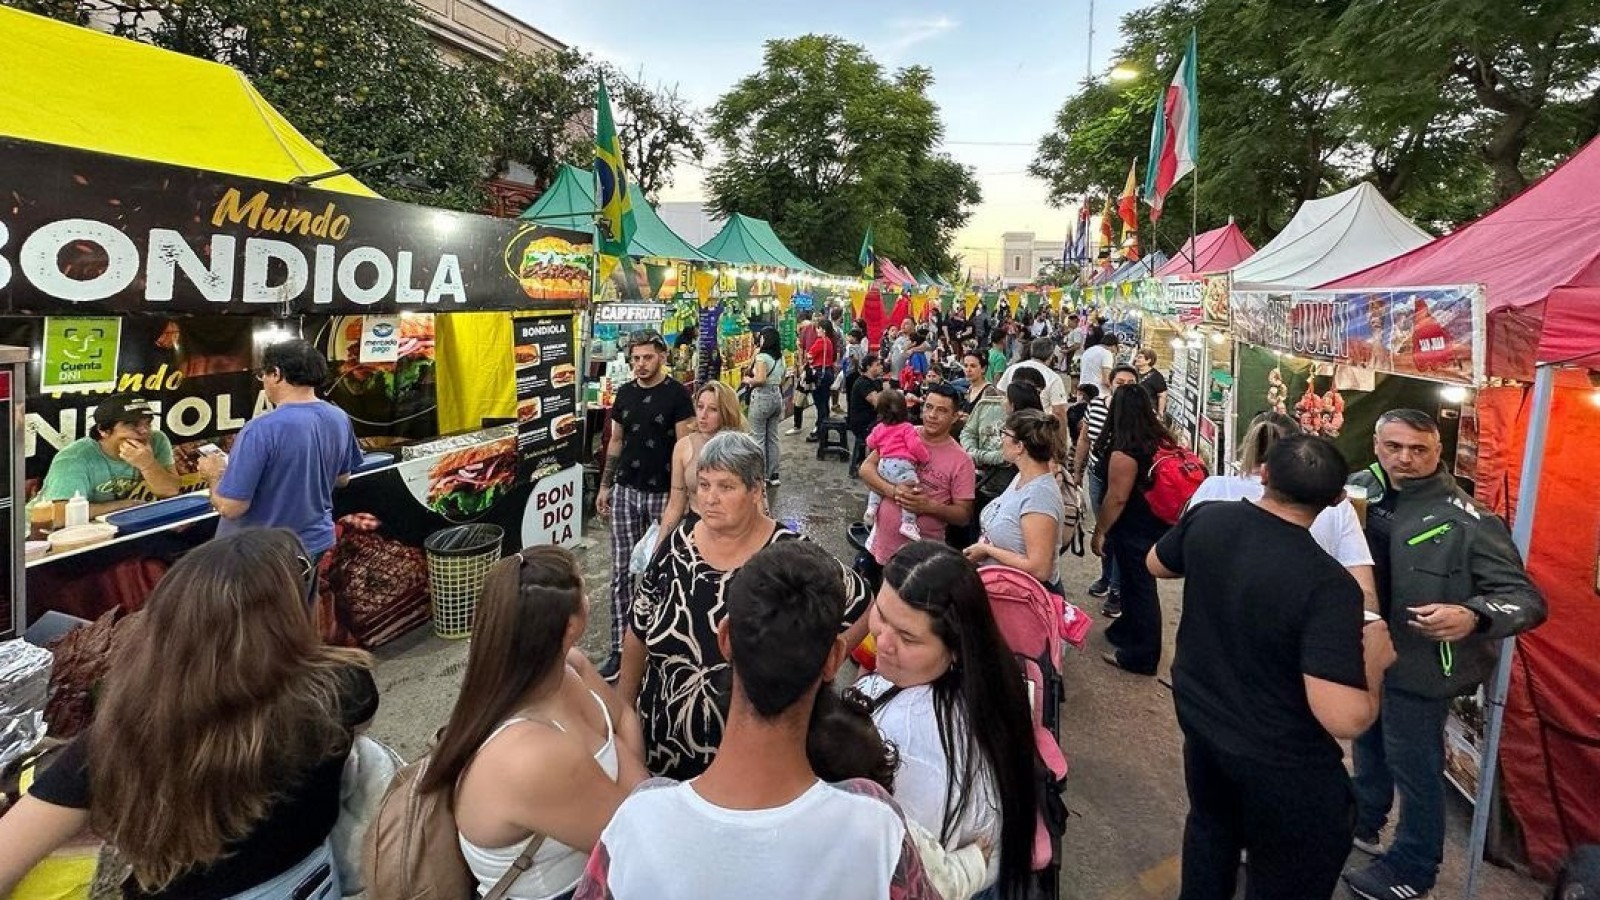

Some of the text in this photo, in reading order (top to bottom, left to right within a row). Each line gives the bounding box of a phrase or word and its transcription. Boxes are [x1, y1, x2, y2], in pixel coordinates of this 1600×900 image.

[212, 187, 350, 241] Mundo
[0, 218, 466, 304] ONDIOLA
[522, 324, 567, 338] BONDIOLA
[1292, 300, 1349, 358] JUAN
[364, 339, 398, 347] mercado
[59, 371, 81, 380] DNI
[61, 361, 102, 372] Cuenta
[537, 481, 575, 511] BON
[543, 502, 574, 530] DIO
[552, 524, 573, 545] LA
